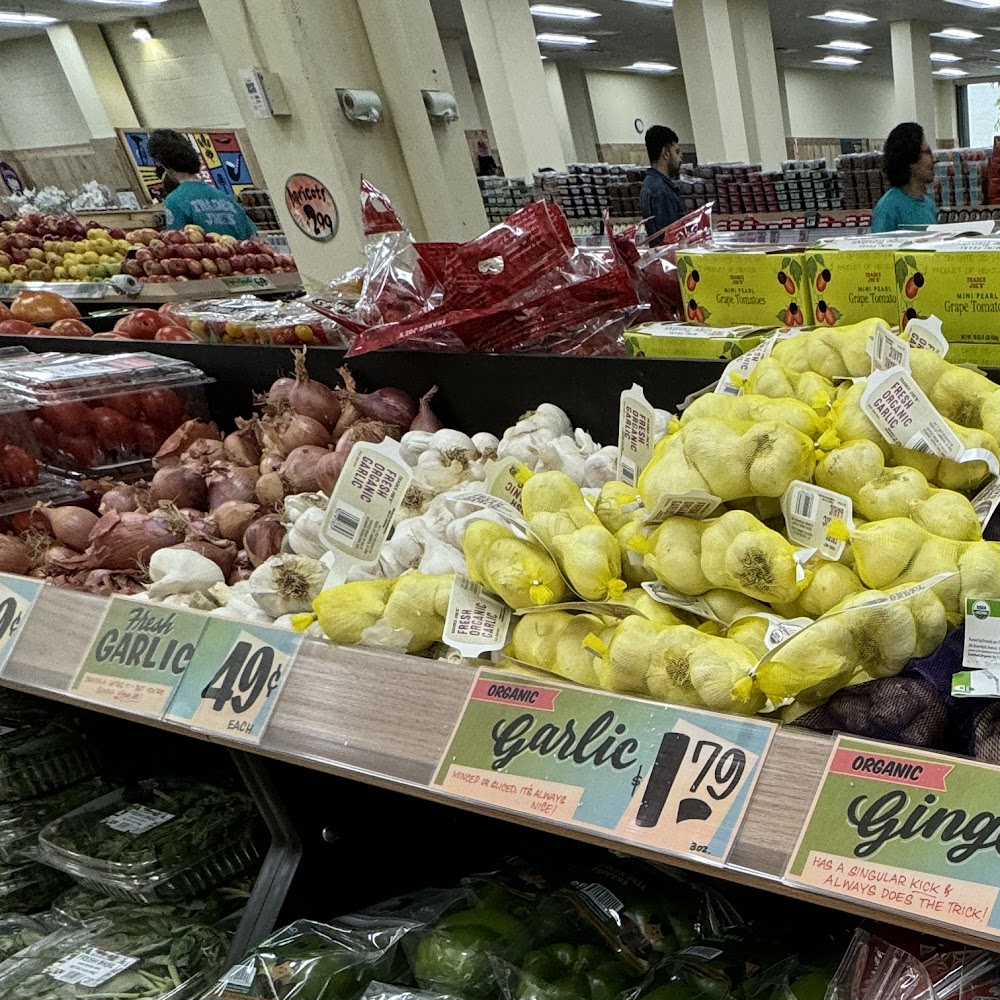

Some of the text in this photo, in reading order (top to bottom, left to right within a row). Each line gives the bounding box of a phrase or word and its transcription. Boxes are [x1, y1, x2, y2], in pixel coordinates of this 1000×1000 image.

[716, 293, 766, 306] Grape Tomatoes
[849, 293, 868, 306] Grape
[945, 300, 970, 315] Grape
[882, 390, 913, 428] ORGANIC
[891, 382, 914, 410] FRESH
[624, 405, 632, 441] GARLIC
[638, 414, 647, 445] FRESH
[873, 398, 899, 430] GARLIC
[631, 409, 639, 452] ORGANIC
[352, 456, 373, 490] GARLIC
[360, 462, 385, 503] ORGANIC
[377, 469, 397, 499] FRESH
[125, 607, 176, 635] Fresh
[457, 609, 472, 635] FRESH
[469, 602, 487, 636] ORGANIC
[482, 612, 498, 638] GARLIC
[95, 628, 195, 675] GARLIC
[201, 641, 282, 714] 49¢
[487, 684, 539, 704] ORGANIC
[227, 719, 254, 735] EACH
[492, 710, 638, 771] Garlic
[851, 755, 924, 782] ORGANIC
[451, 770, 567, 804] MINCED OR SLICED, IT'S ALWAYS
[531, 801, 557, 816] NICE!
[812, 856, 833, 870] HAS
[836, 862, 844, 874] A
[848, 865, 907, 887] SINGULAR
[909, 878, 941, 895] KICK
[823, 874, 989, 922] ALWAYS DOES THE TRICK!
